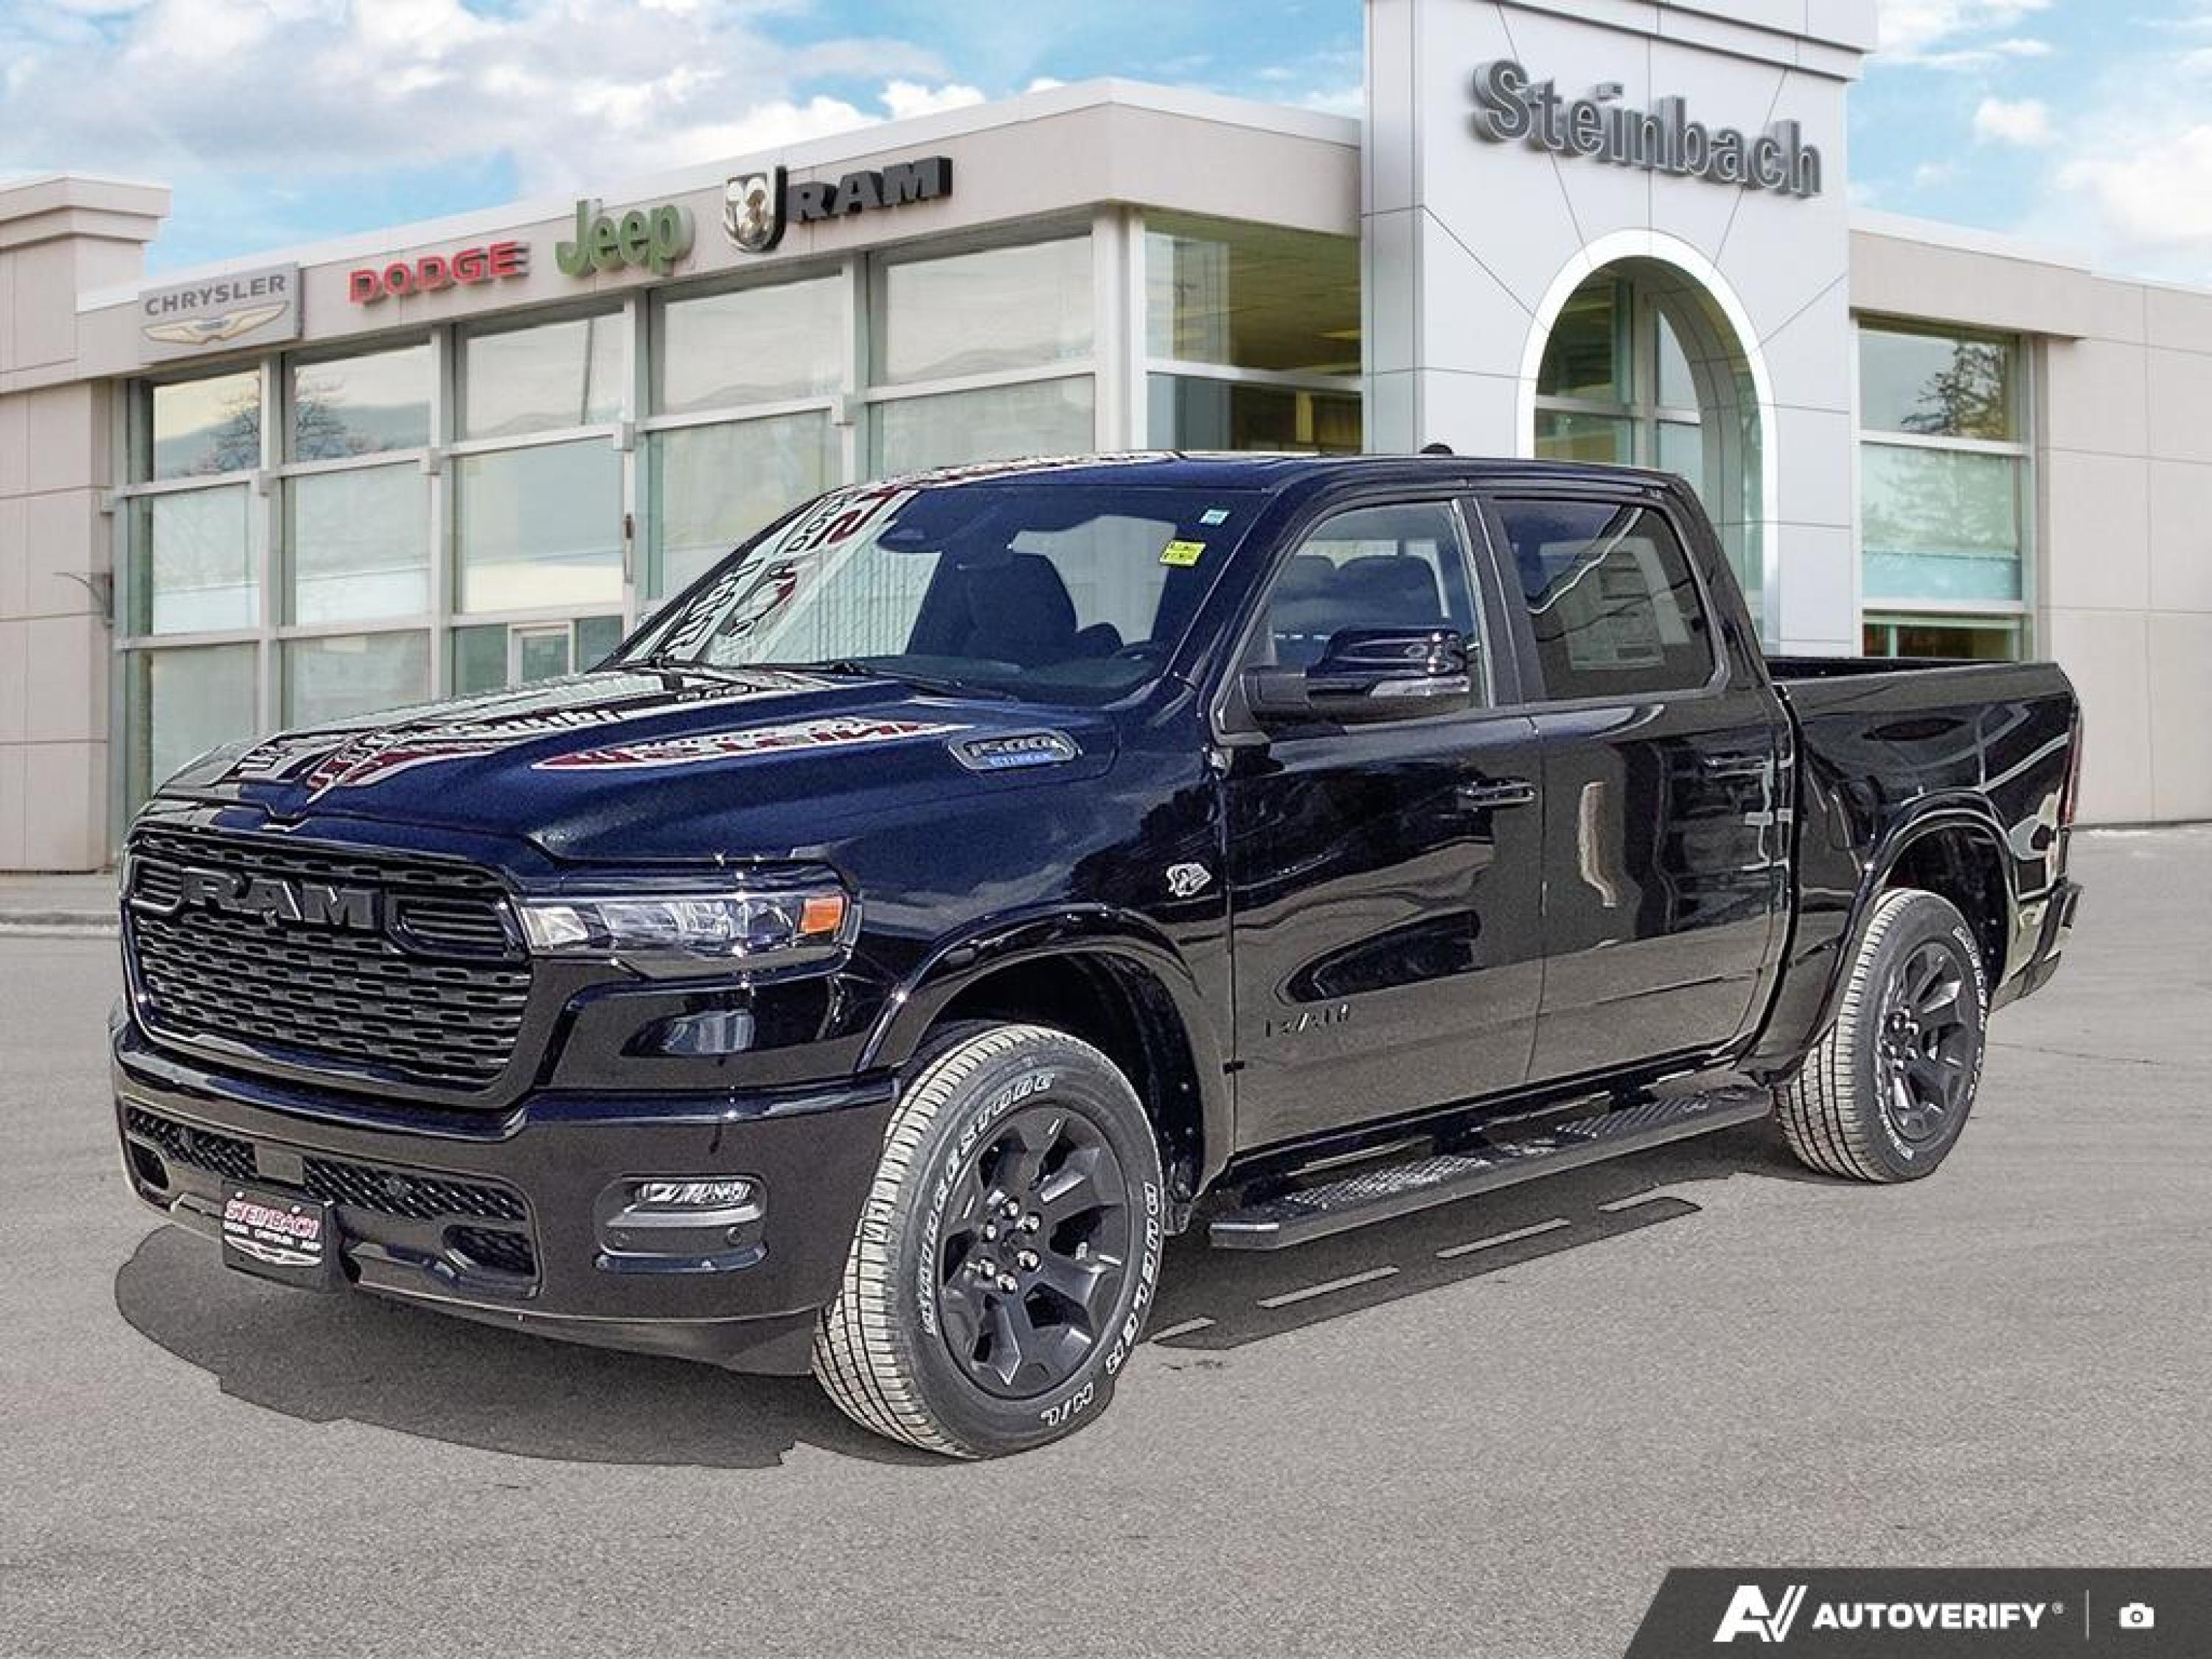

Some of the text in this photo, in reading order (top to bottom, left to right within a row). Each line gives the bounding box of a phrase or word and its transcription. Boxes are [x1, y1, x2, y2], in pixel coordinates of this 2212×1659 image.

[1477, 60, 1822, 197] Steinbach
[786, 157, 951, 221] RAM
[555, 199, 690, 277] Jeep
[145, 274, 286, 316] CHRYSLER
[349, 241, 527, 304] DODGE
[180, 868, 379, 929] RAM
